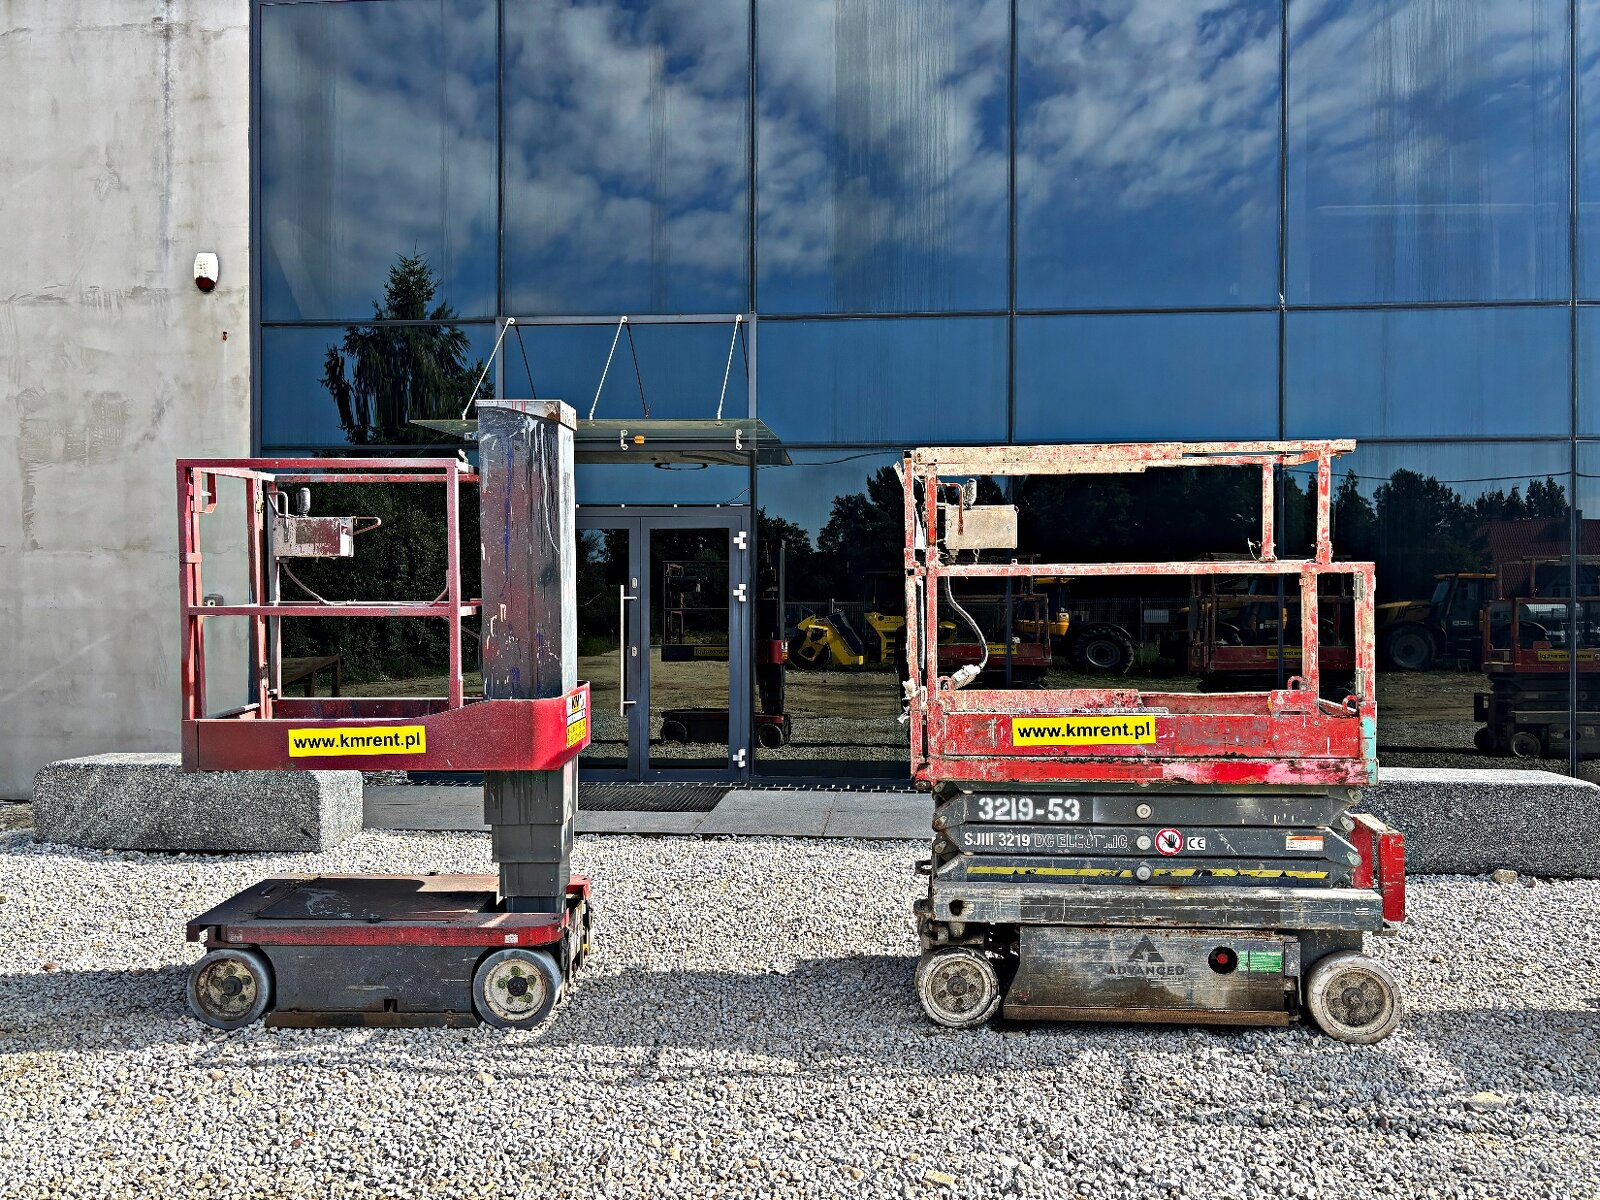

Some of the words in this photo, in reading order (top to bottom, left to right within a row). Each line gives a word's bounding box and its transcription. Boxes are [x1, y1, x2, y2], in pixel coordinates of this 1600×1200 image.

[1017, 721, 1151, 739] www.kmrent.pl
[293, 732, 421, 749] www.kmrent.pl
[978, 797, 1080, 821] 3219-53
[998, 832, 1031, 847] 3219
[1034, 833, 1055, 848] DC
[1107, 965, 1185, 976] ADVANCED
